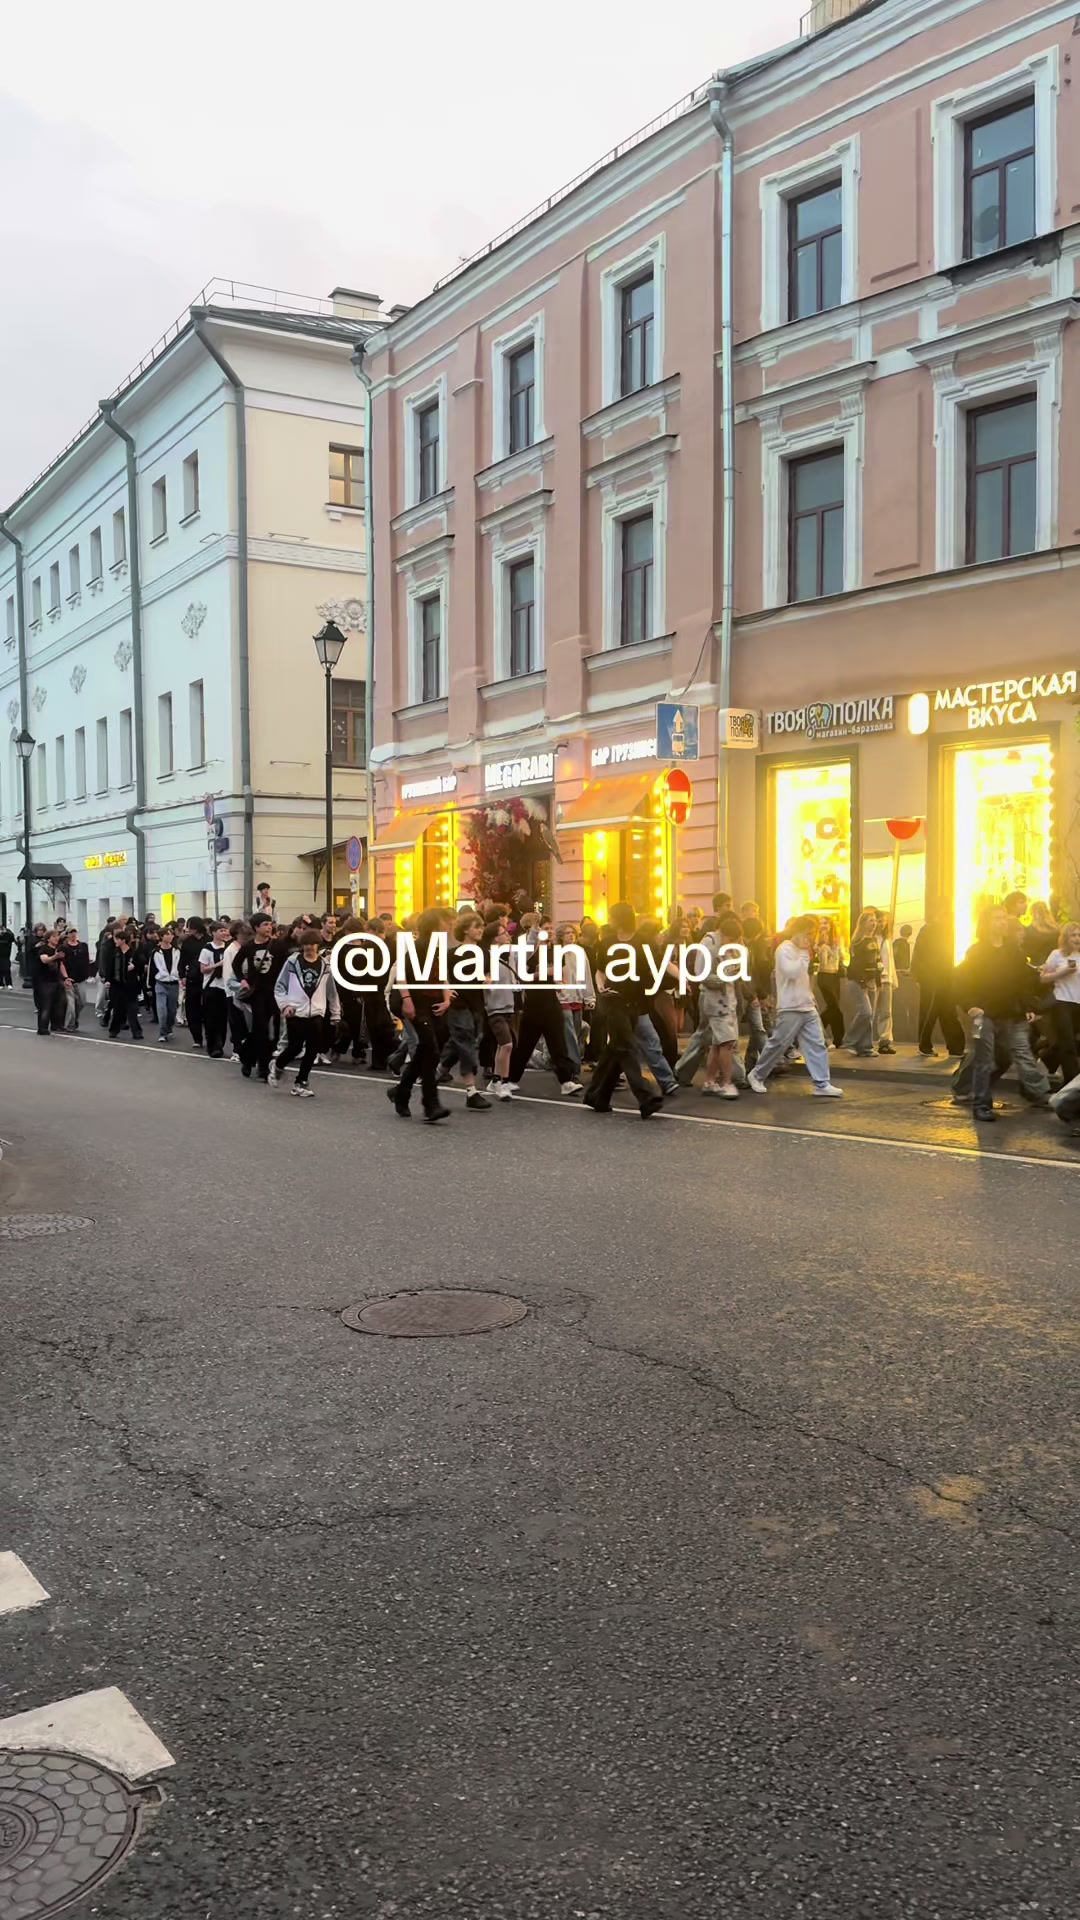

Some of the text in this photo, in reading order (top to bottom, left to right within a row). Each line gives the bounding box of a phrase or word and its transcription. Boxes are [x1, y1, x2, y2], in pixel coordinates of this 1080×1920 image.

[934, 671, 1077, 711] МАСТЕРСКАЯ
[766, 696, 893, 734] ТВОЯ ПОЛКА
[967, 701, 1037, 729] ВКУСА
